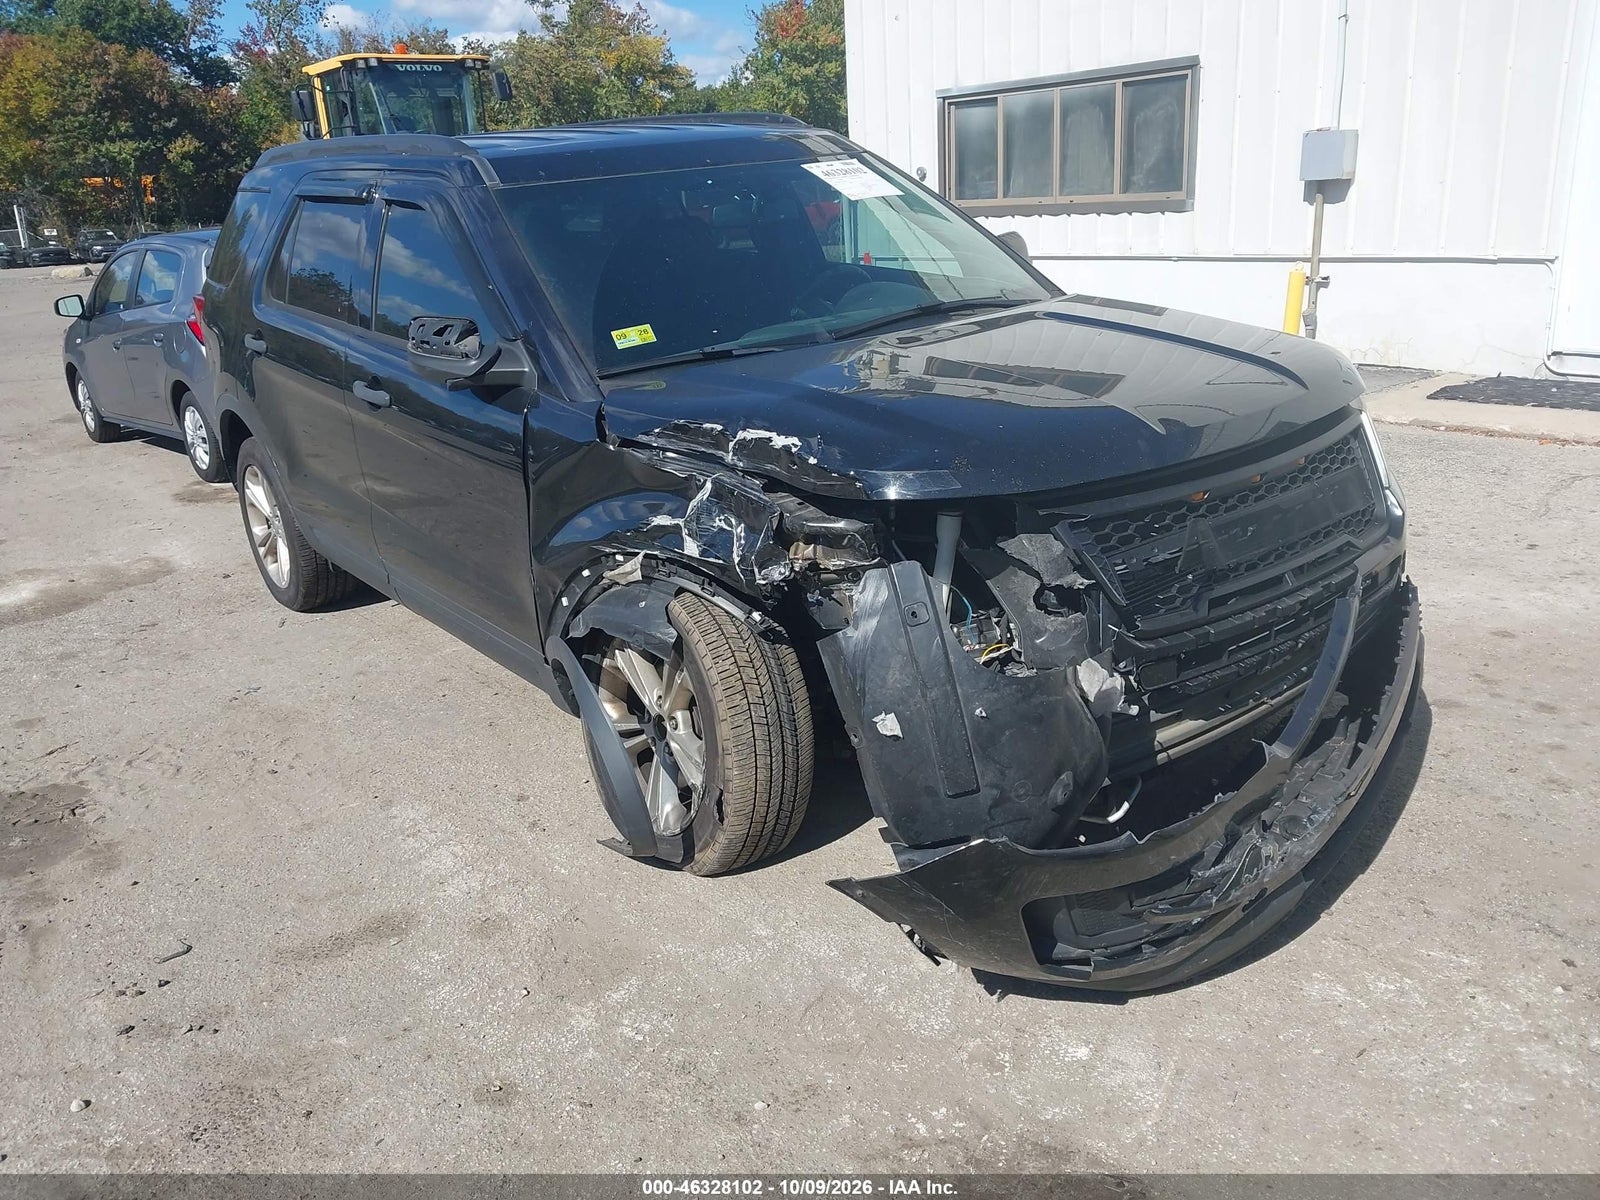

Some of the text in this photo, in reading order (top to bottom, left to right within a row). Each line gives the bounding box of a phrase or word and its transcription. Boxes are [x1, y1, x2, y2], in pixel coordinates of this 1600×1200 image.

[395, 64, 443, 72] VOLVO
[615, 328, 650, 341] 09 28
